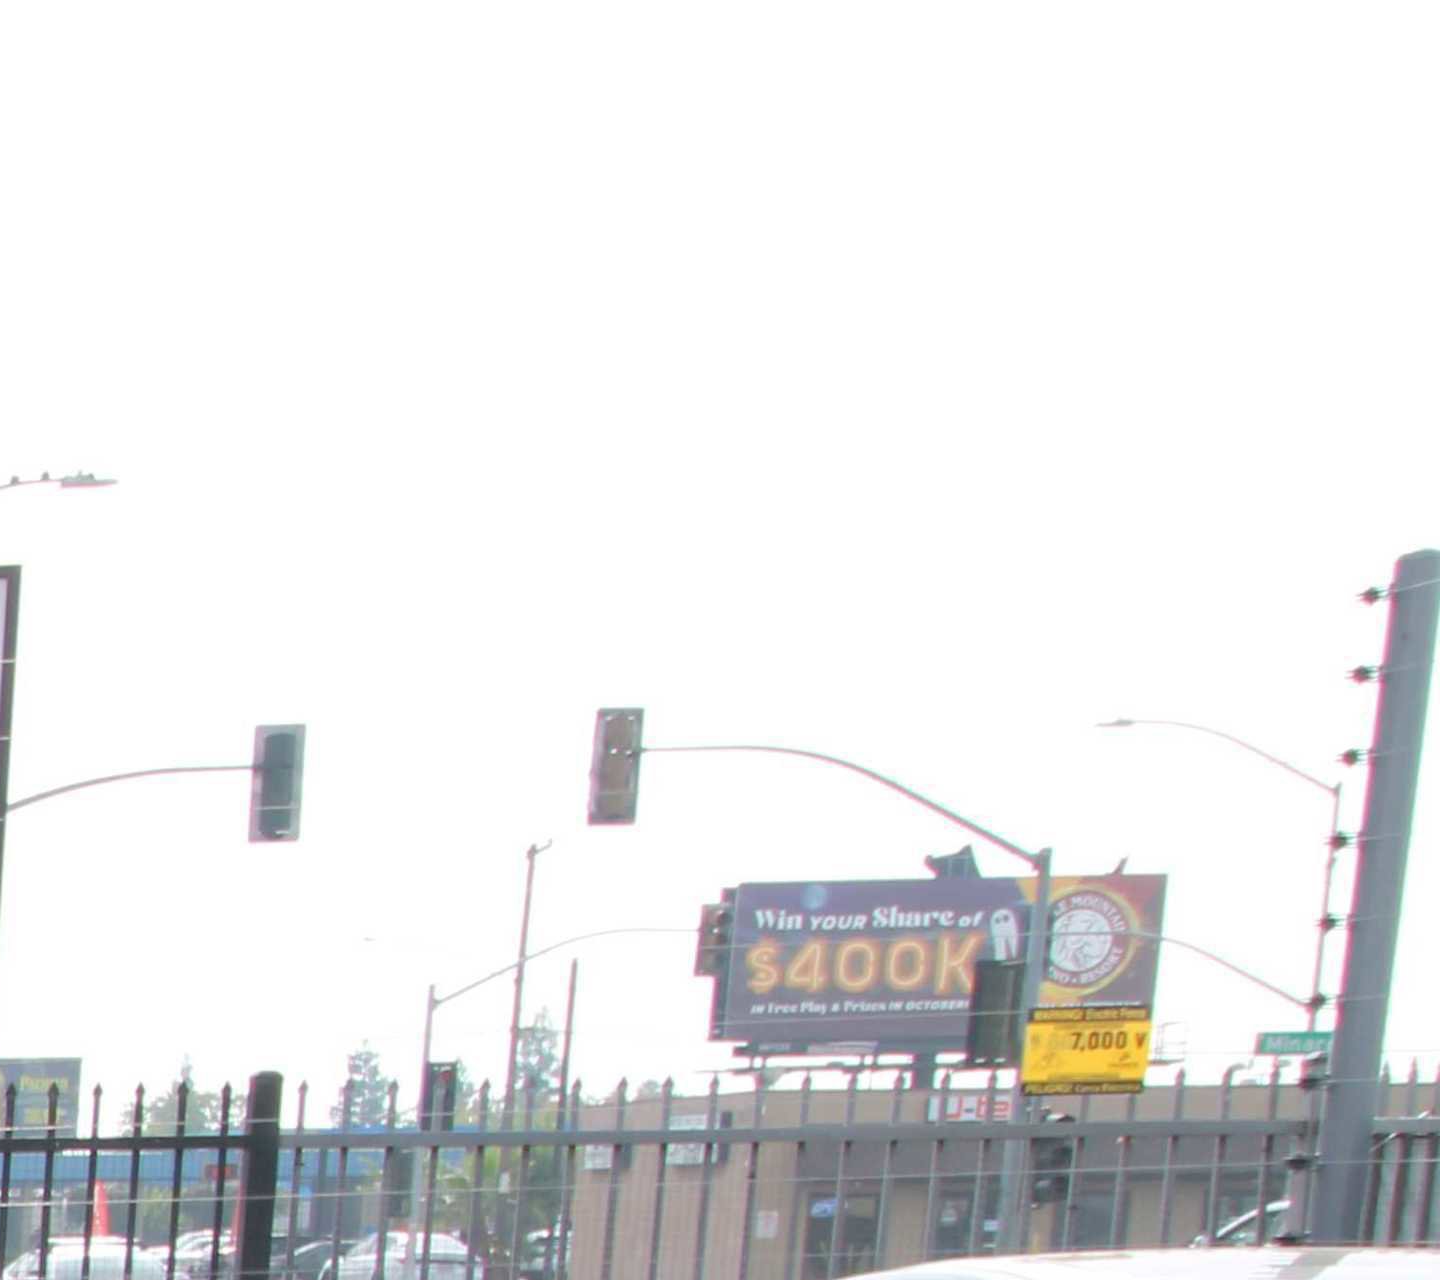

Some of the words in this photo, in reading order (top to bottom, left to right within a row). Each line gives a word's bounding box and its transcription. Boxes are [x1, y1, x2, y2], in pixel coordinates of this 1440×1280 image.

[754, 909, 803, 931] Win
[810, 914, 867, 931] YOUR
[871, 904, 955, 929] Share
[958, 910, 985, 927] of
[746, 931, 984, 994] $400K
[800, 1001, 827, 1015] Play
[1071, 1031, 1128, 1052] 7,000
[1135, 1032, 1146, 1047] V
